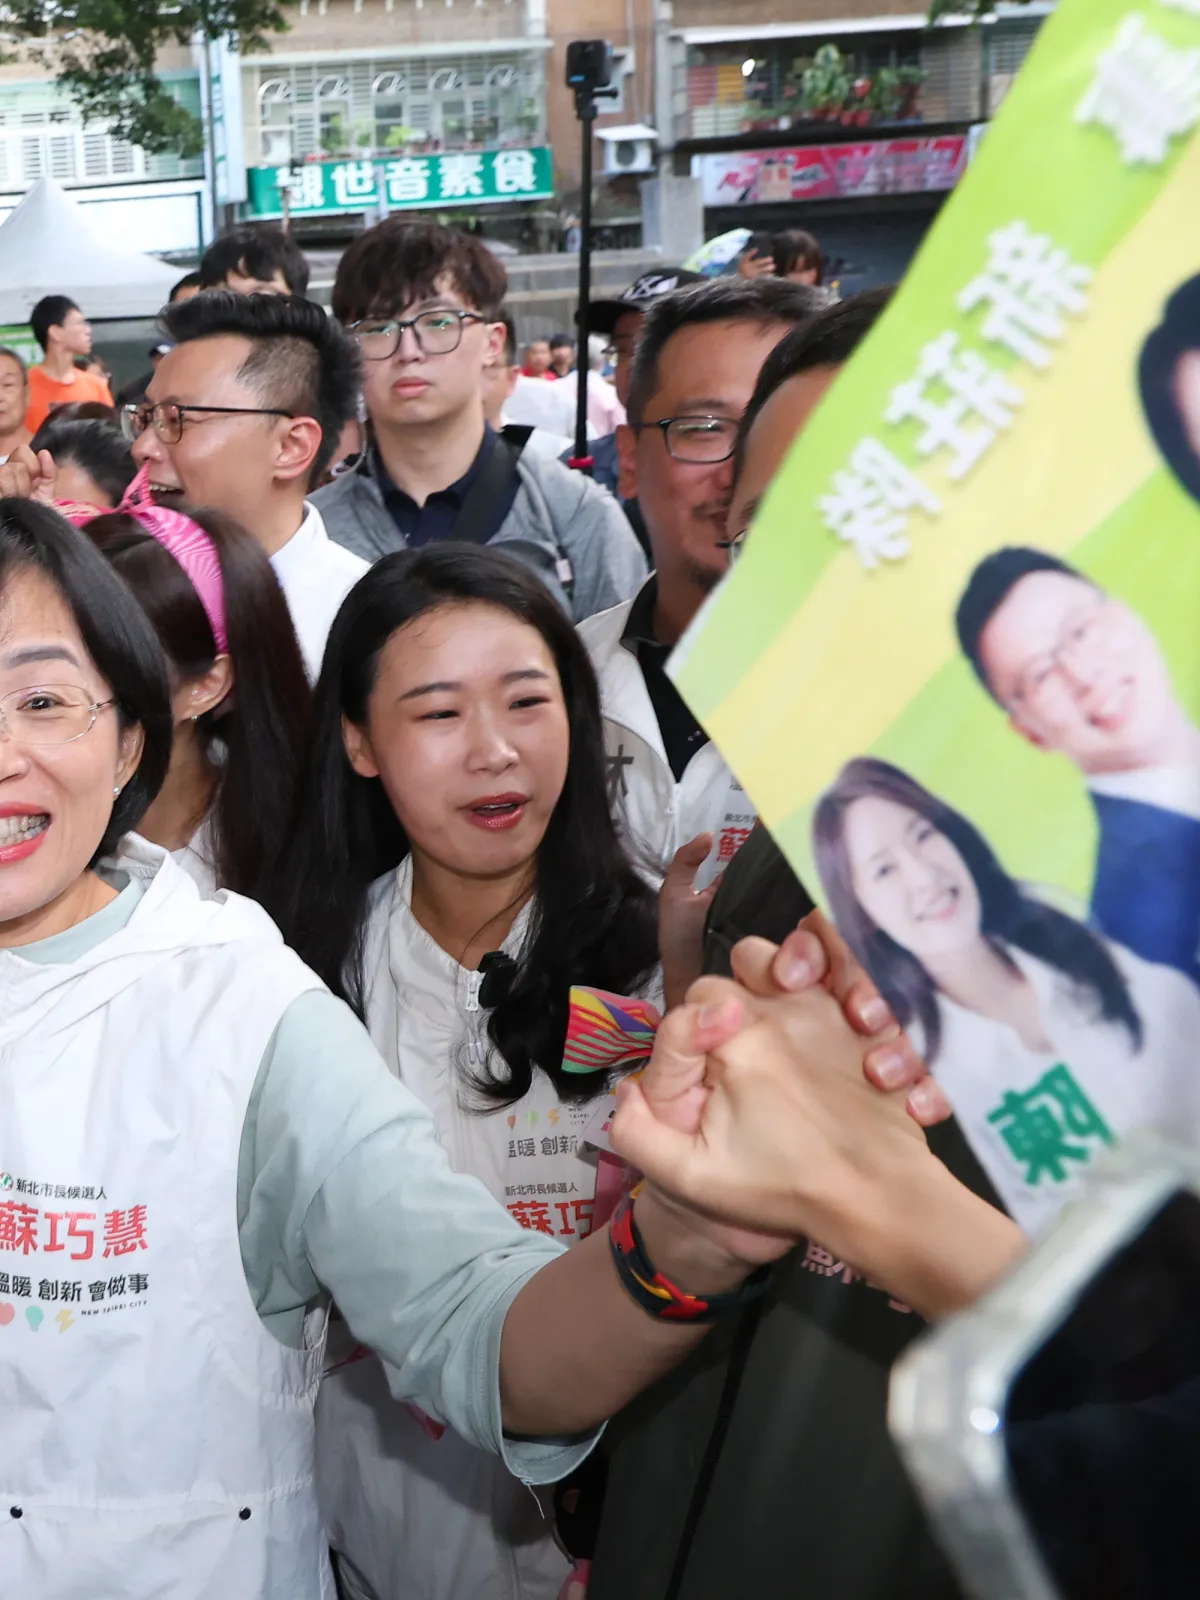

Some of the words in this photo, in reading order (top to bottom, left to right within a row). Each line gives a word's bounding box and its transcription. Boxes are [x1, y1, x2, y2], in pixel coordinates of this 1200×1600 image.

[275, 150, 537, 209] 觀世音素食
[540, 1135, 578, 1156] 創新
[16, 1178, 107, 1200] 新北市長候選人
[505, 1182, 578, 1196] 新北市長候選人
[38, 1278, 82, 1302] 創新
[88, 1272, 149, 1302] 會做事
[103, 1303, 127, 1314] TAIPEI
[129, 1299, 147, 1308] CITY
